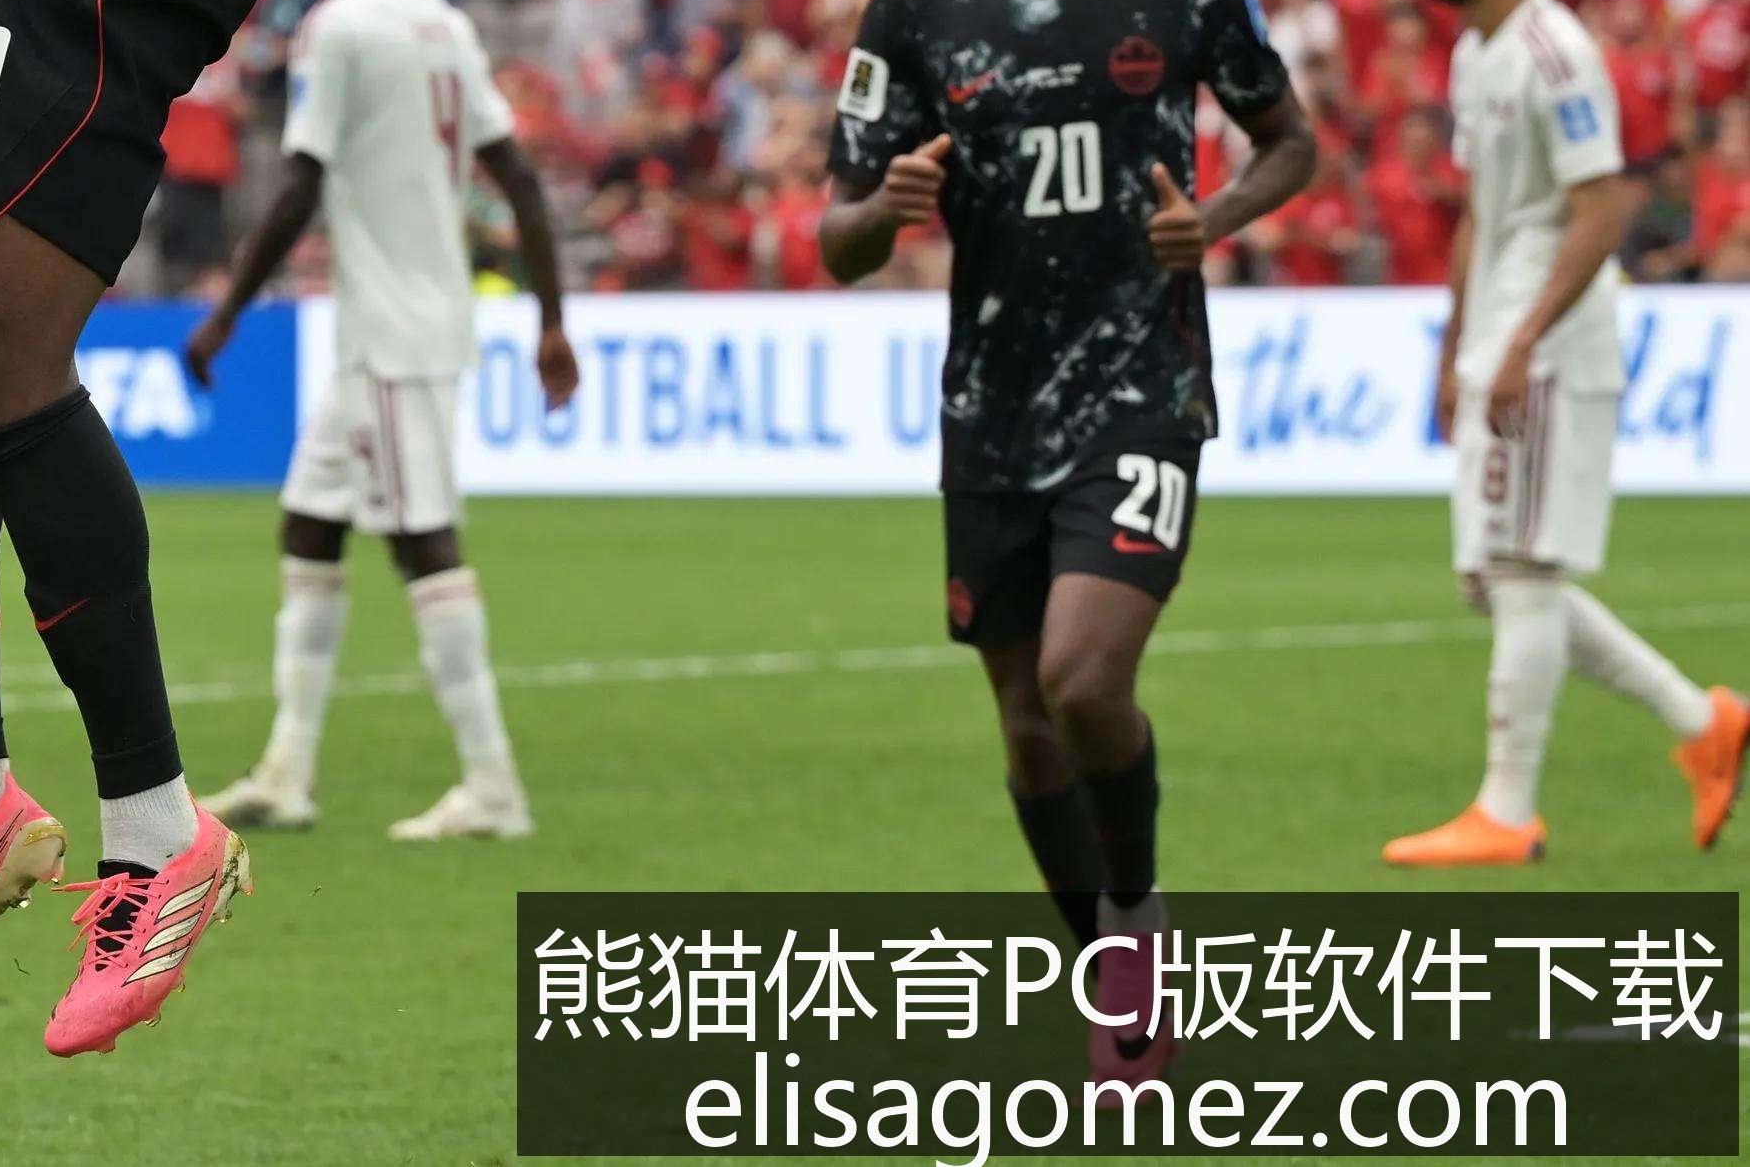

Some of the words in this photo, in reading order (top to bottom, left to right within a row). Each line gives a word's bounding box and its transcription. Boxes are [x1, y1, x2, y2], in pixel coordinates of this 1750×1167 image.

[1019, 121, 1103, 217] 20
[74, 347, 198, 440] FA
[476, 335, 846, 447] OTBALL
[1112, 453, 1188, 549] 20
